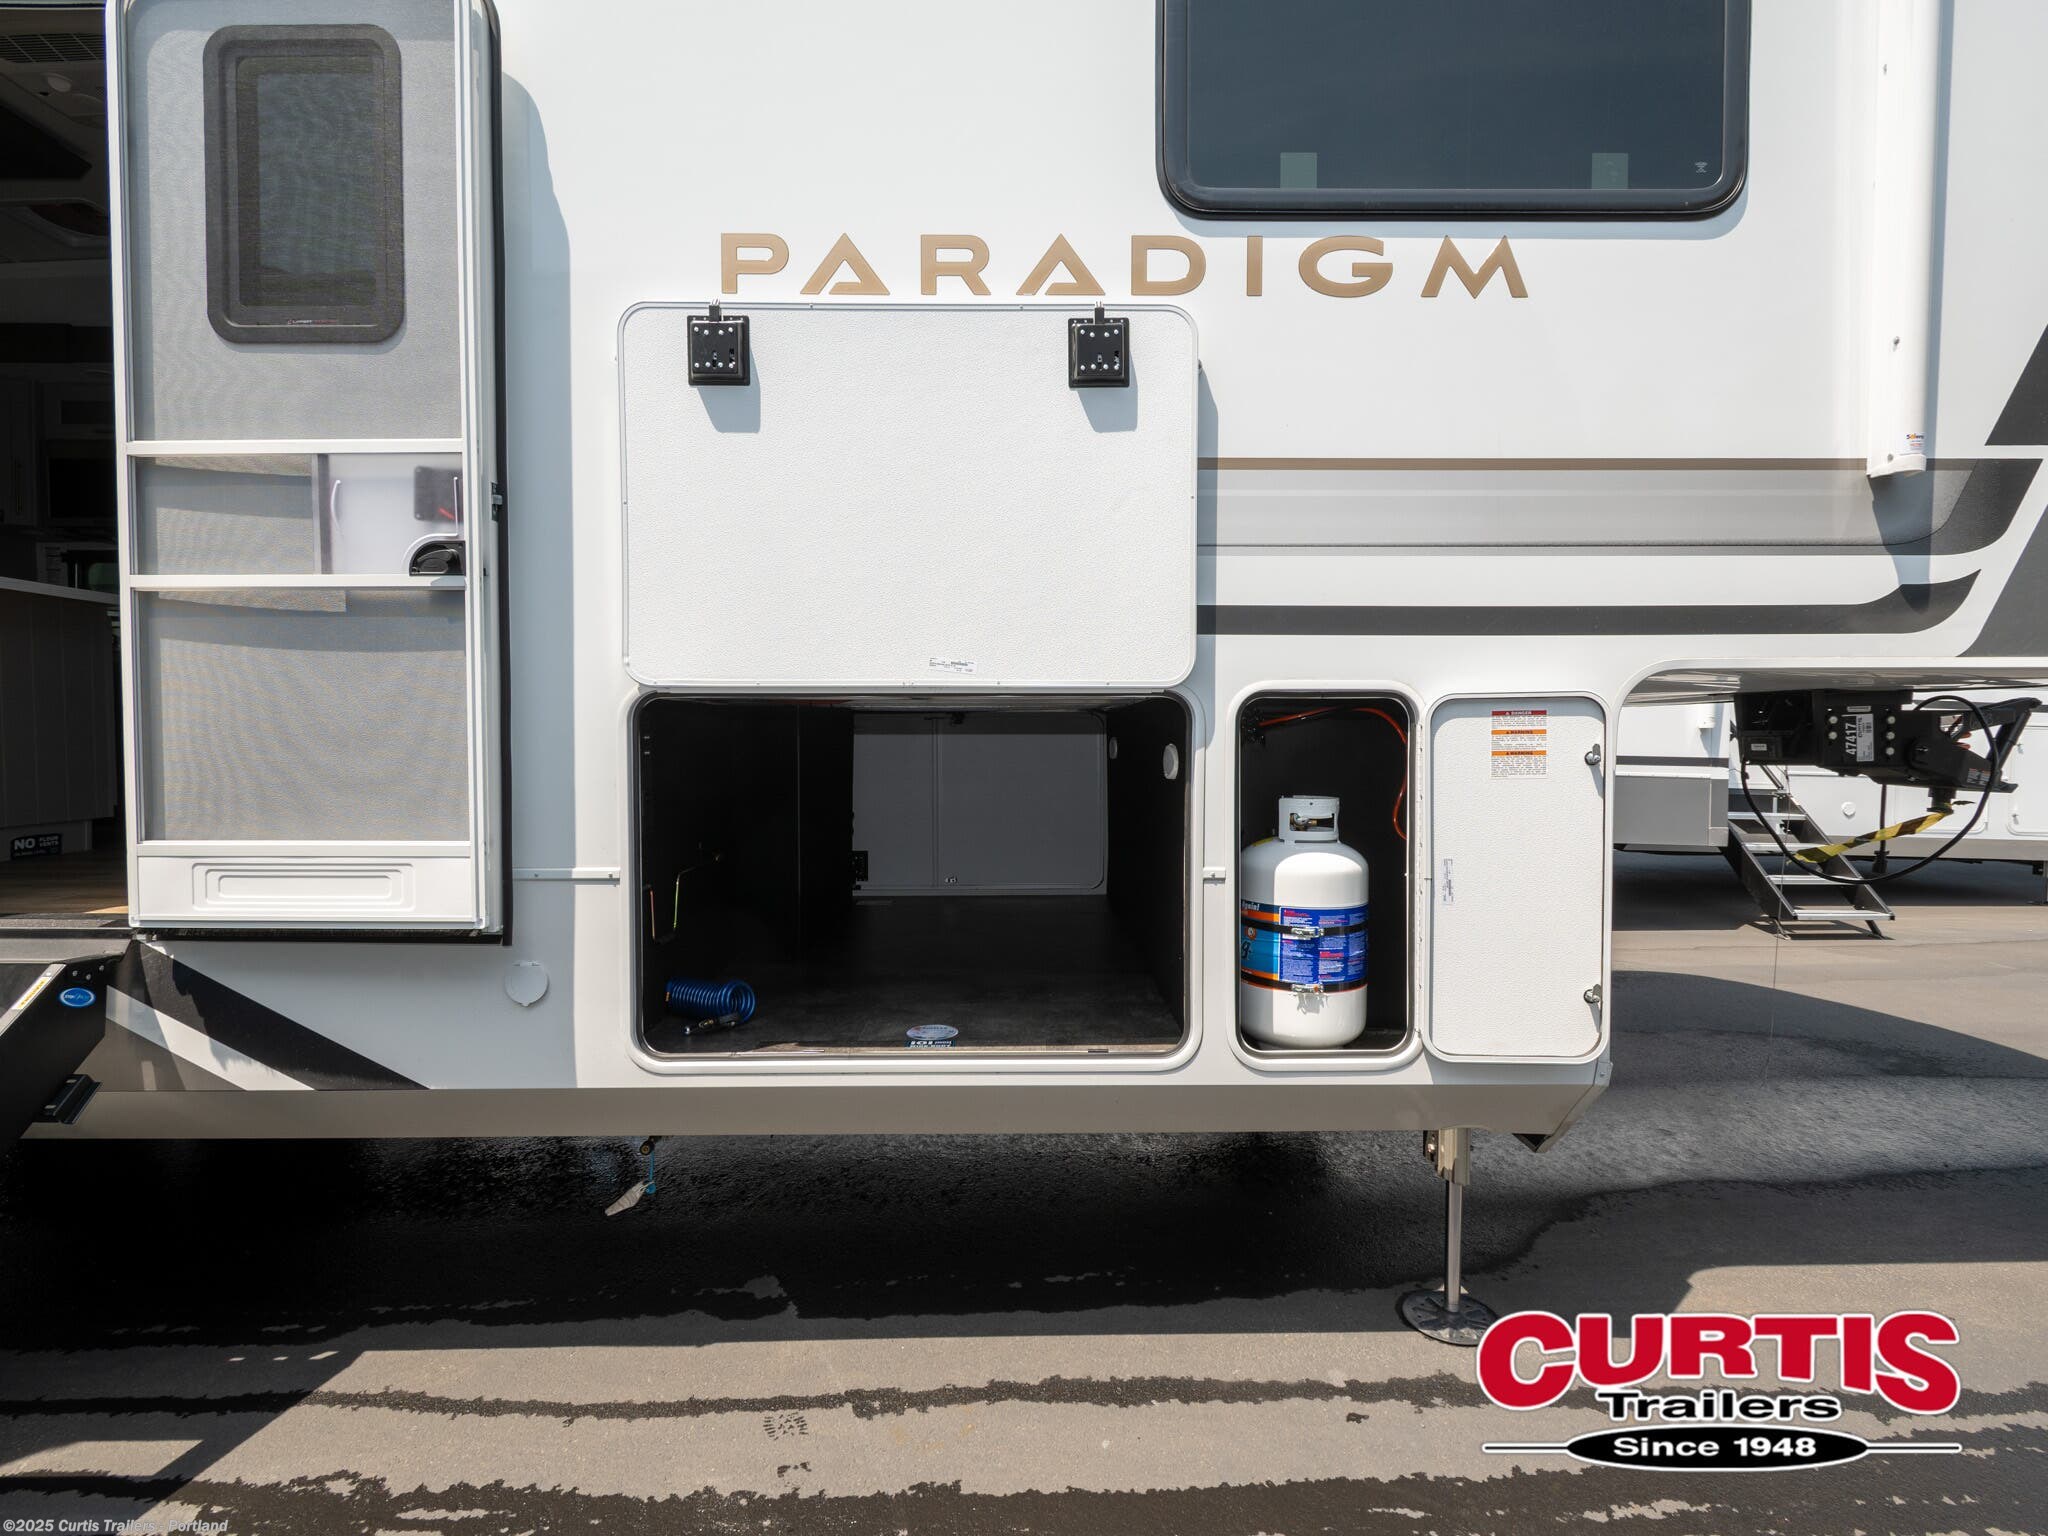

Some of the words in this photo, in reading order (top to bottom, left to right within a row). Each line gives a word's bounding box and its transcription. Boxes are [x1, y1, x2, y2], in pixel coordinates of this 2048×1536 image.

[721, 233, 1528, 298] PARADIGM
[1845, 722, 1857, 755] 47417
[14, 838, 36, 850] NO
